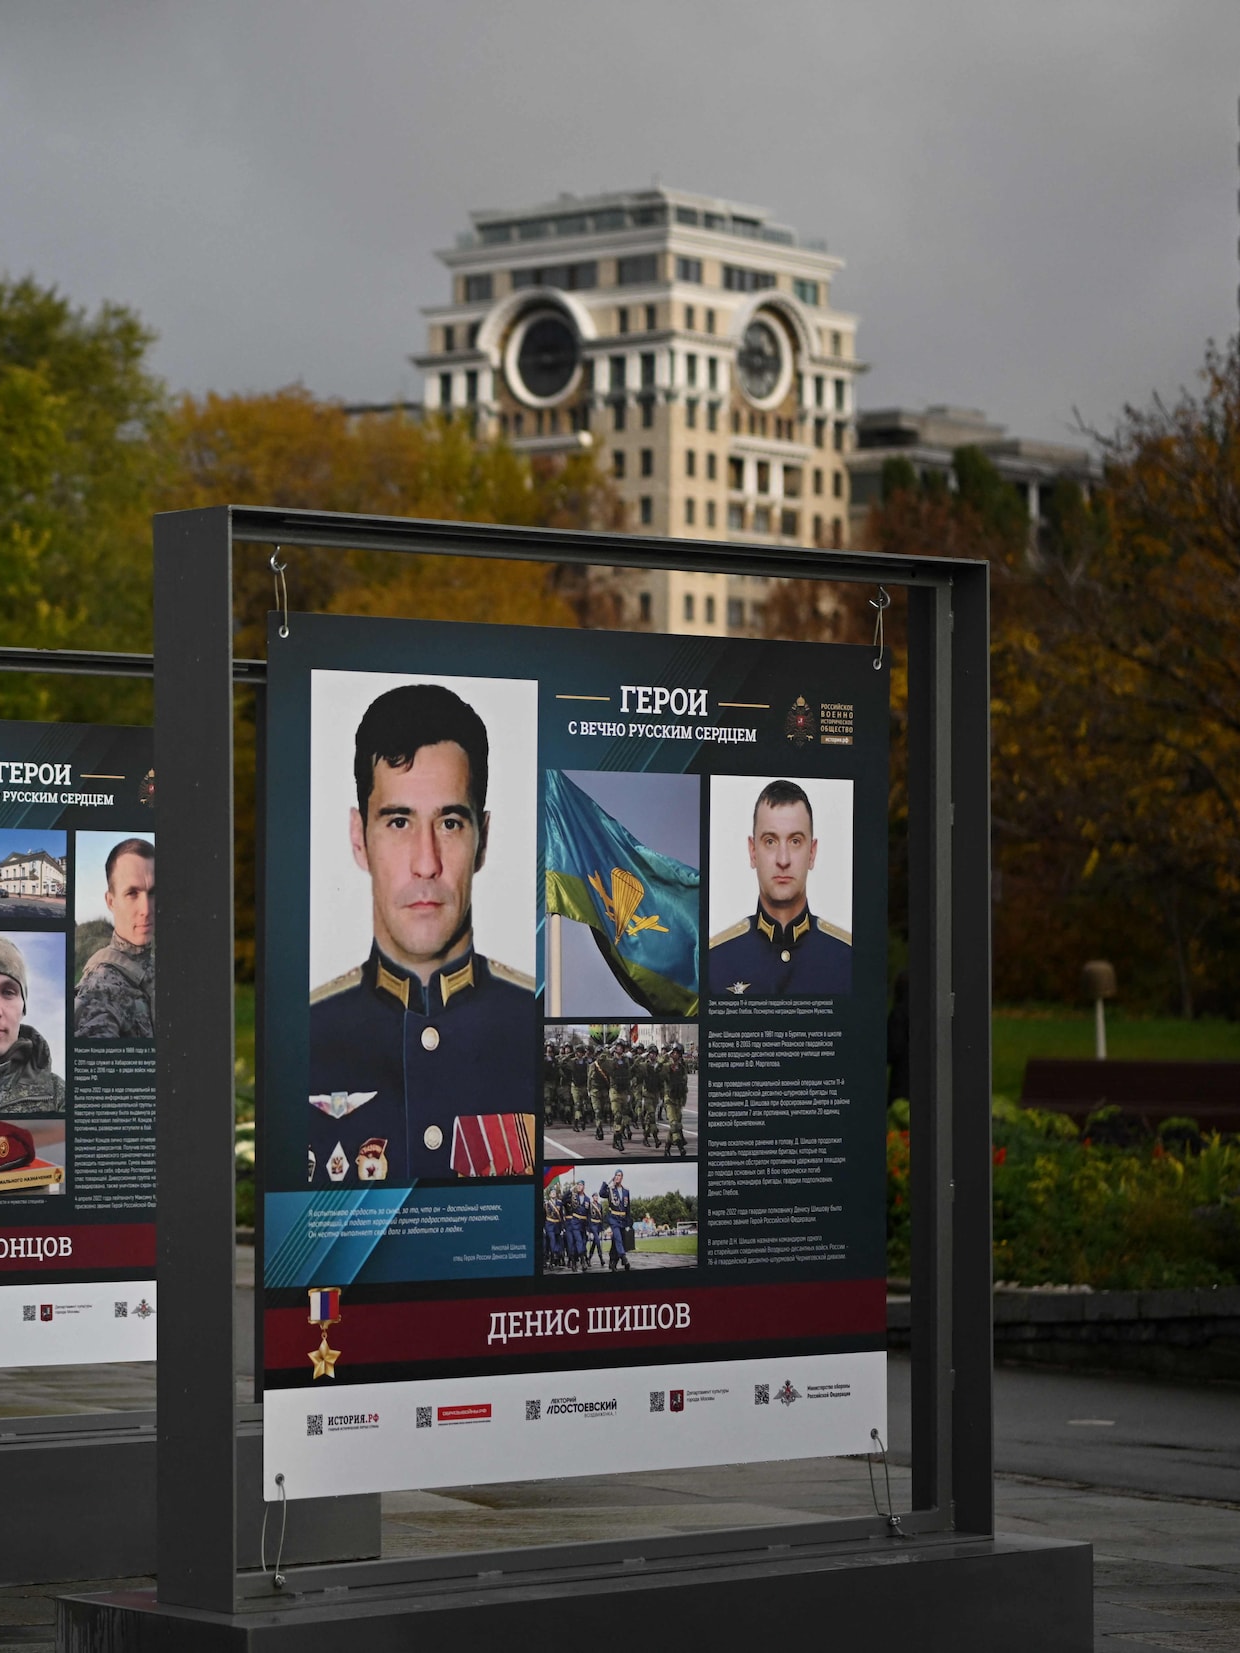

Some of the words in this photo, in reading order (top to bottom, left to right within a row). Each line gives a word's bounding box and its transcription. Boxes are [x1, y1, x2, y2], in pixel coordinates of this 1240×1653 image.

[620, 685, 709, 717] ГЕРОИ
[821, 703, 853, 711] РОССИЙСКОЕ
[568, 721, 577, 735] С
[580, 721, 626, 738] ВЕЧНО
[628, 725, 692, 740] РУССКИМ
[695, 726, 757, 744] СЕРДЦЕМ
[3, 791, 58, 804] РУССКИМ
[61, 792, 114, 806] СЕРДЦЕМ
[487, 1309, 580, 1344] ДЕНИС
[587, 1303, 691, 1334] ШИШОВ
[550, 1396, 576, 1404] ЛЕКТОРИЙ
[807, 1391, 829, 1399] Российской
[328, 1413, 379, 1426] ИСТОРИЯ.РФ
